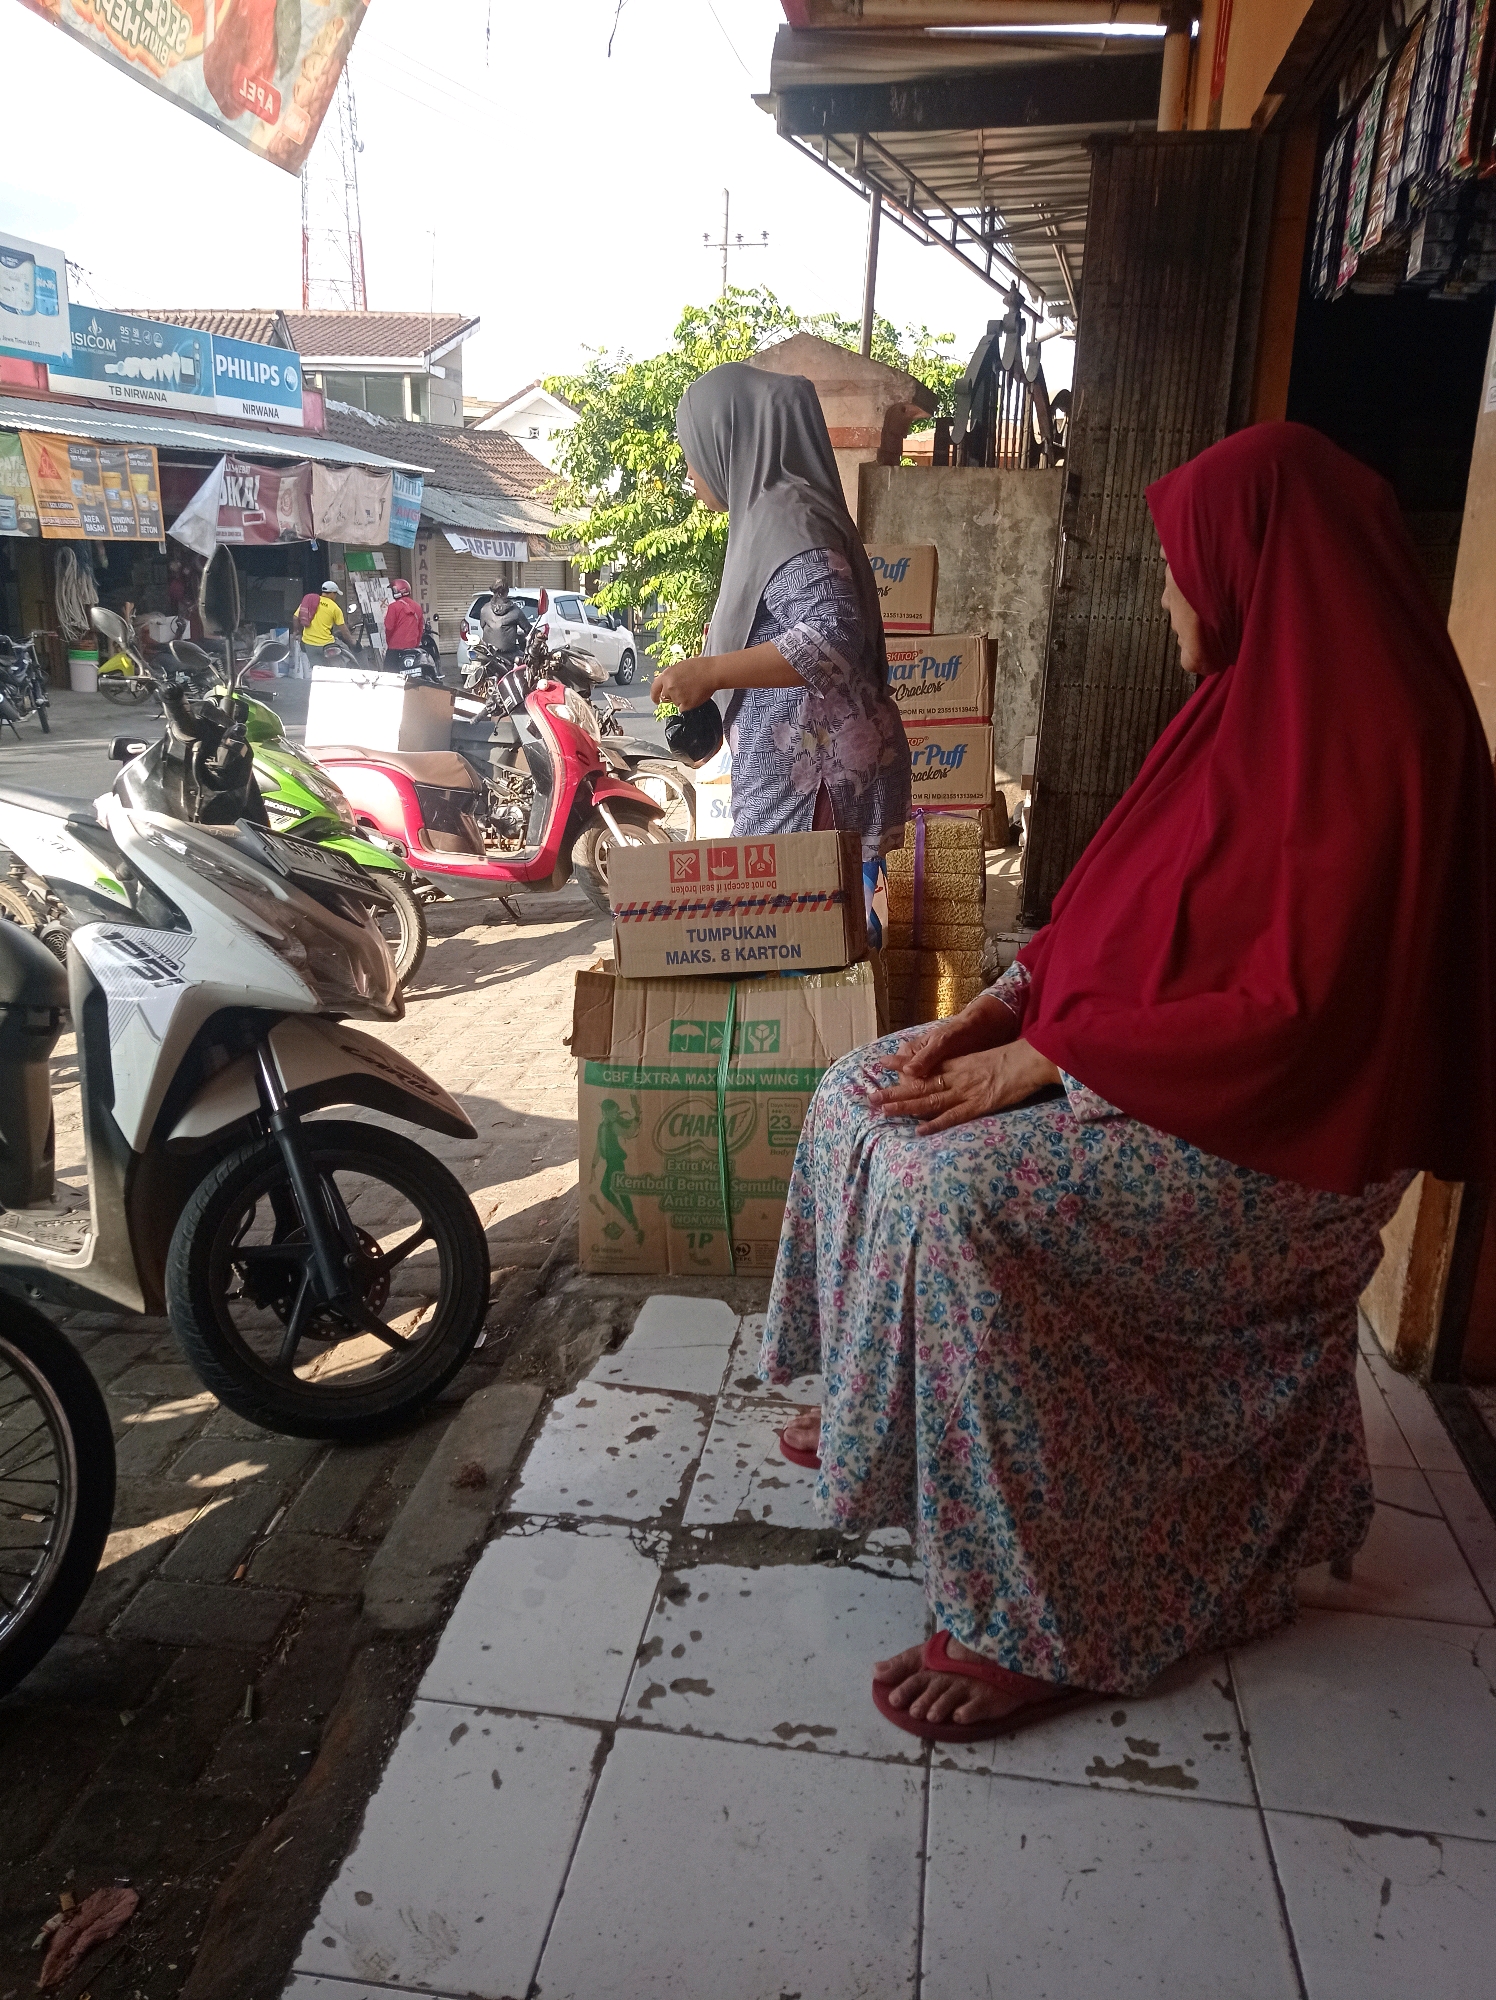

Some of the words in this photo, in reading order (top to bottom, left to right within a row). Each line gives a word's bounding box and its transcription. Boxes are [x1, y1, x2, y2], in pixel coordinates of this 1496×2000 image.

[71, 331, 117, 352] ISICOM
[215, 354, 280, 387] PHILIPS
[109, 385, 122, 396] TB
[123, 387, 167, 403] NIRWANA
[242, 403, 280, 419] NIRWANA
[83, 514, 101, 523] AREA
[869, 556, 911, 583] Puff
[418, 543, 431, 628] PARFU
[887, 651, 919, 661] SKITOP
[919, 654, 963, 681] Puff
[895, 680, 945, 702] Crackers
[906, 737, 924, 746] TOP
[924, 743, 968, 769] Puff
[911, 765, 951, 782] rackers
[264, 799, 302, 816] HONDA
[710, 799, 732, 819] Su
[671, 885, 698, 894] broken
[700, 883, 714, 894] seal
[723, 880, 750, 892] accept
[751, 880, 765, 890] not
[766, 879, 777, 889] Do
[686, 924, 777, 943] TUMPUKAN
[665, 948, 716, 966] MAKS.
[721, 949, 731, 962] 8
[735, 944, 802, 961] KARTON
[602, 1070, 630, 1083] CBF
[633, 1071, 679, 1085] EXTRA
[685, 1072, 719, 1086] MAX
[726, 1073, 756, 1086] NON
[759, 1074, 799, 1086] WING
[668, 1112, 738, 1138] CHARM
[769, 1115, 792, 1130] 23
[667, 1159, 699, 1172] Extra
[701, 1160, 733, 1173] Mai
[615, 1174, 674, 1191] Kembali
[677, 1175, 727, 1192] Bentu
[731, 1179, 787, 1193] Semula
[663, 1195, 694, 1208] Anti
[674, 1214, 698, 1225] NON
[687, 1233, 714, 1249] 1P
